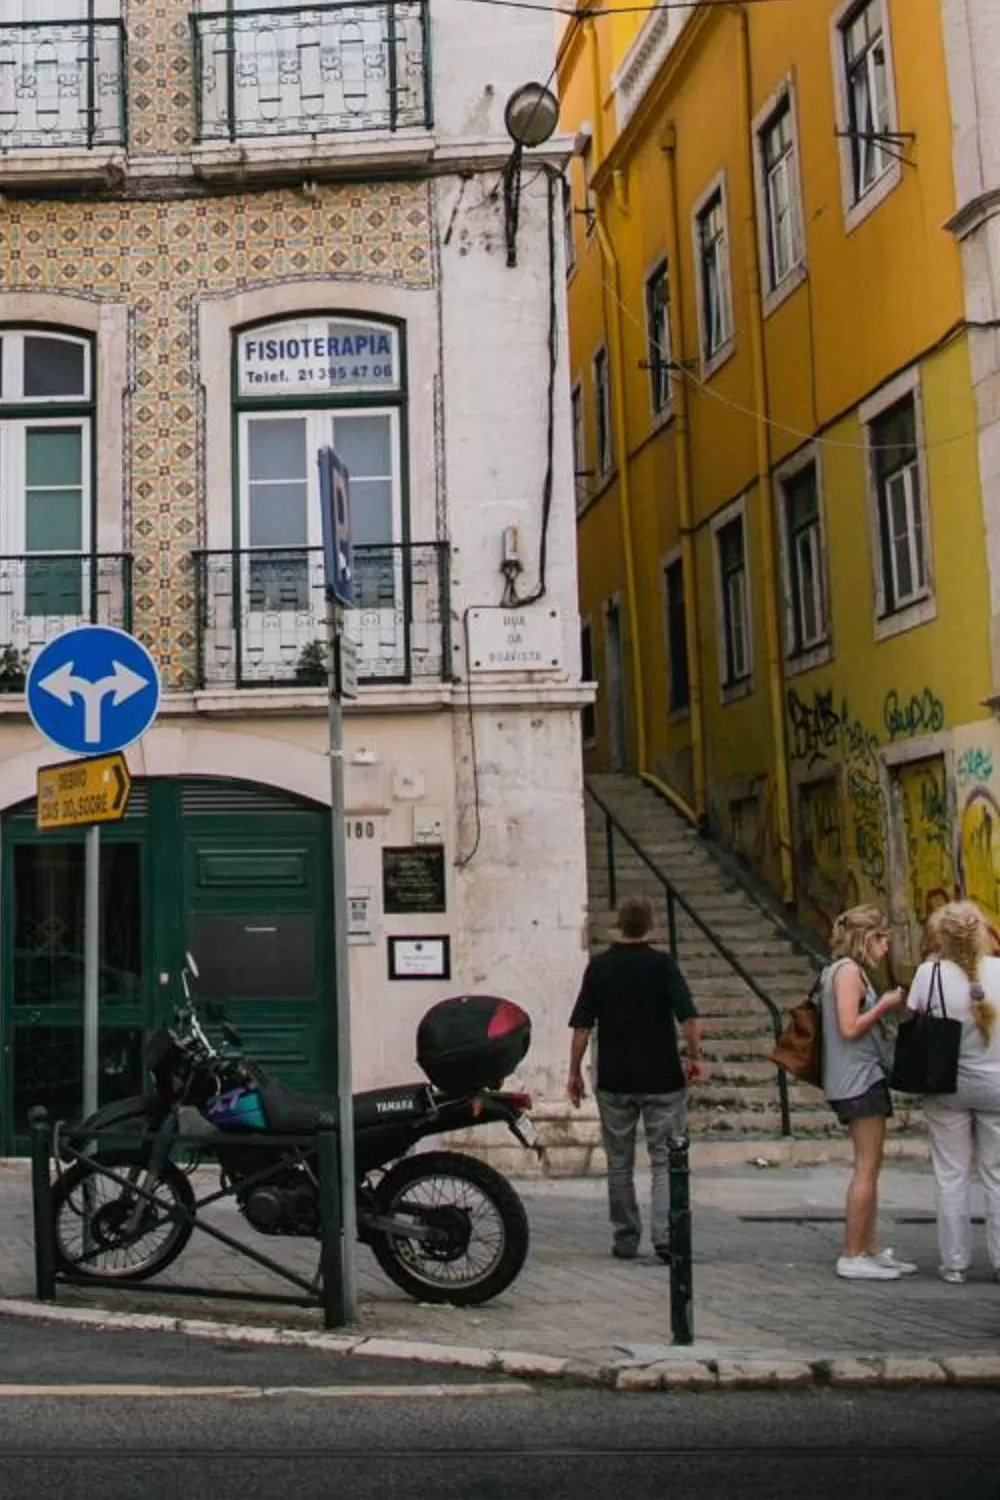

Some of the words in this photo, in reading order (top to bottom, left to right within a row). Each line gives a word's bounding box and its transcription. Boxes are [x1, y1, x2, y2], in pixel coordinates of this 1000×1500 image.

[245, 335, 391, 360] FISIOTERAPIA
[247, 370, 289, 383] Telef.
[298, 368, 313, 381] 21
[347, 821, 375, 838] 180
[376, 1100, 413, 1112] YAMAHA
